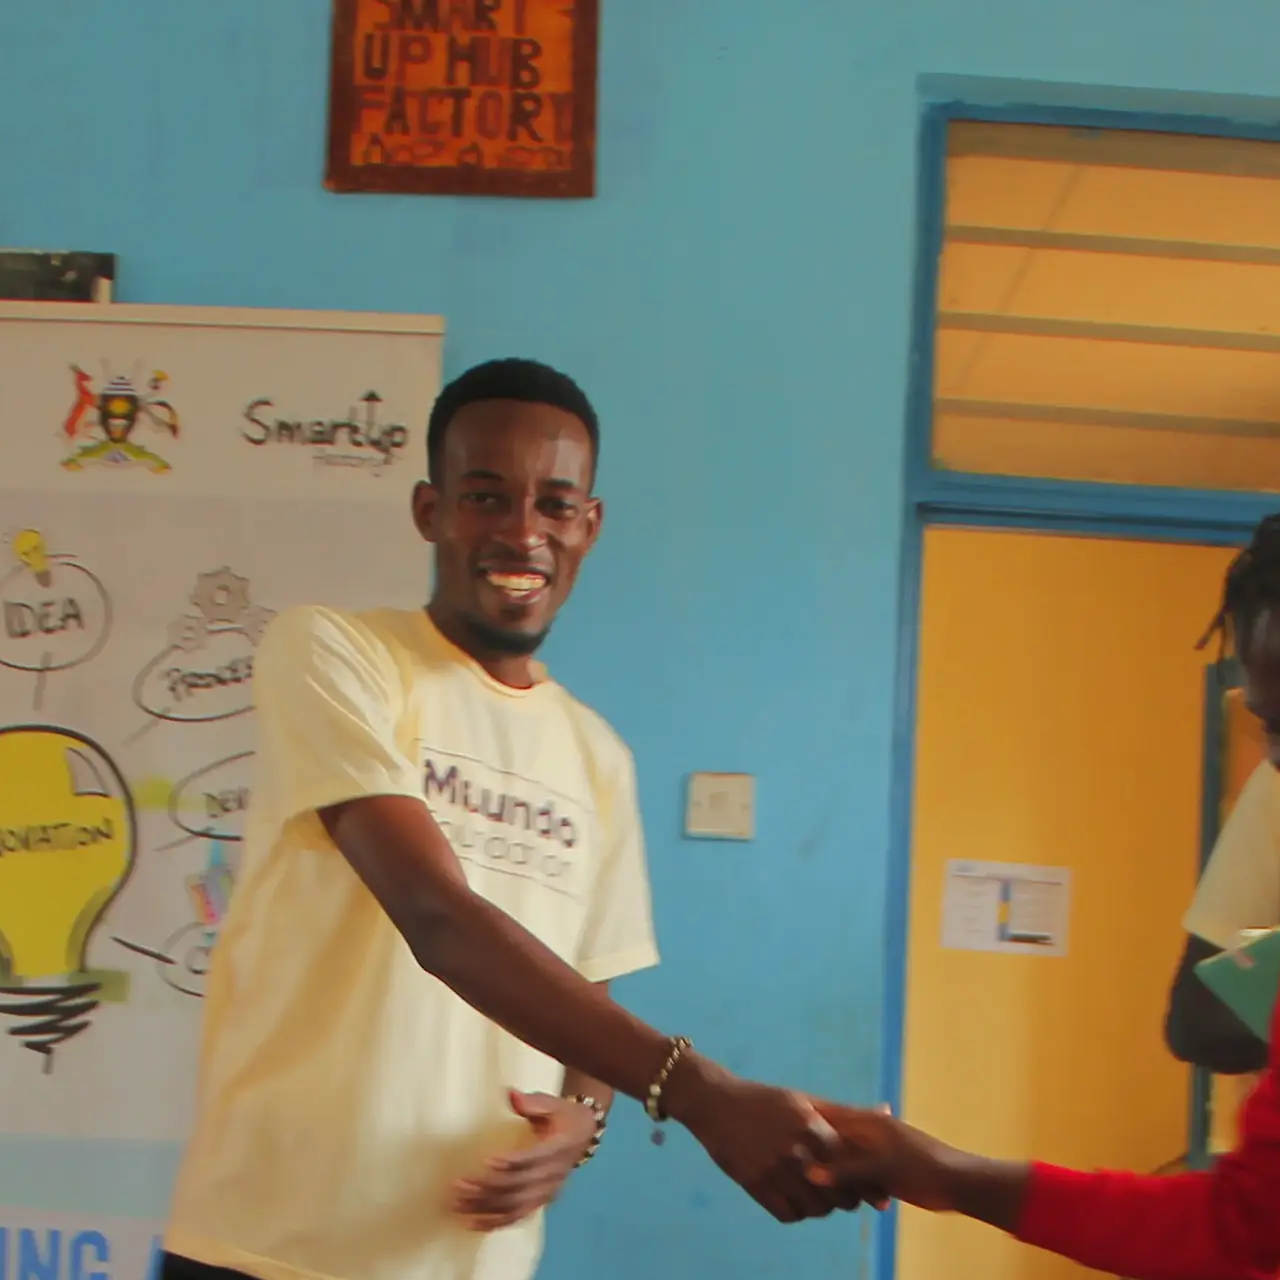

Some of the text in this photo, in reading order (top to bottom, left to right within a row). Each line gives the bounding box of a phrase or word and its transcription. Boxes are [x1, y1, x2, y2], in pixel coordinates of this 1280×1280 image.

[363, 32, 543, 90] UP HUB
[3, 597, 86, 640] IDEA
